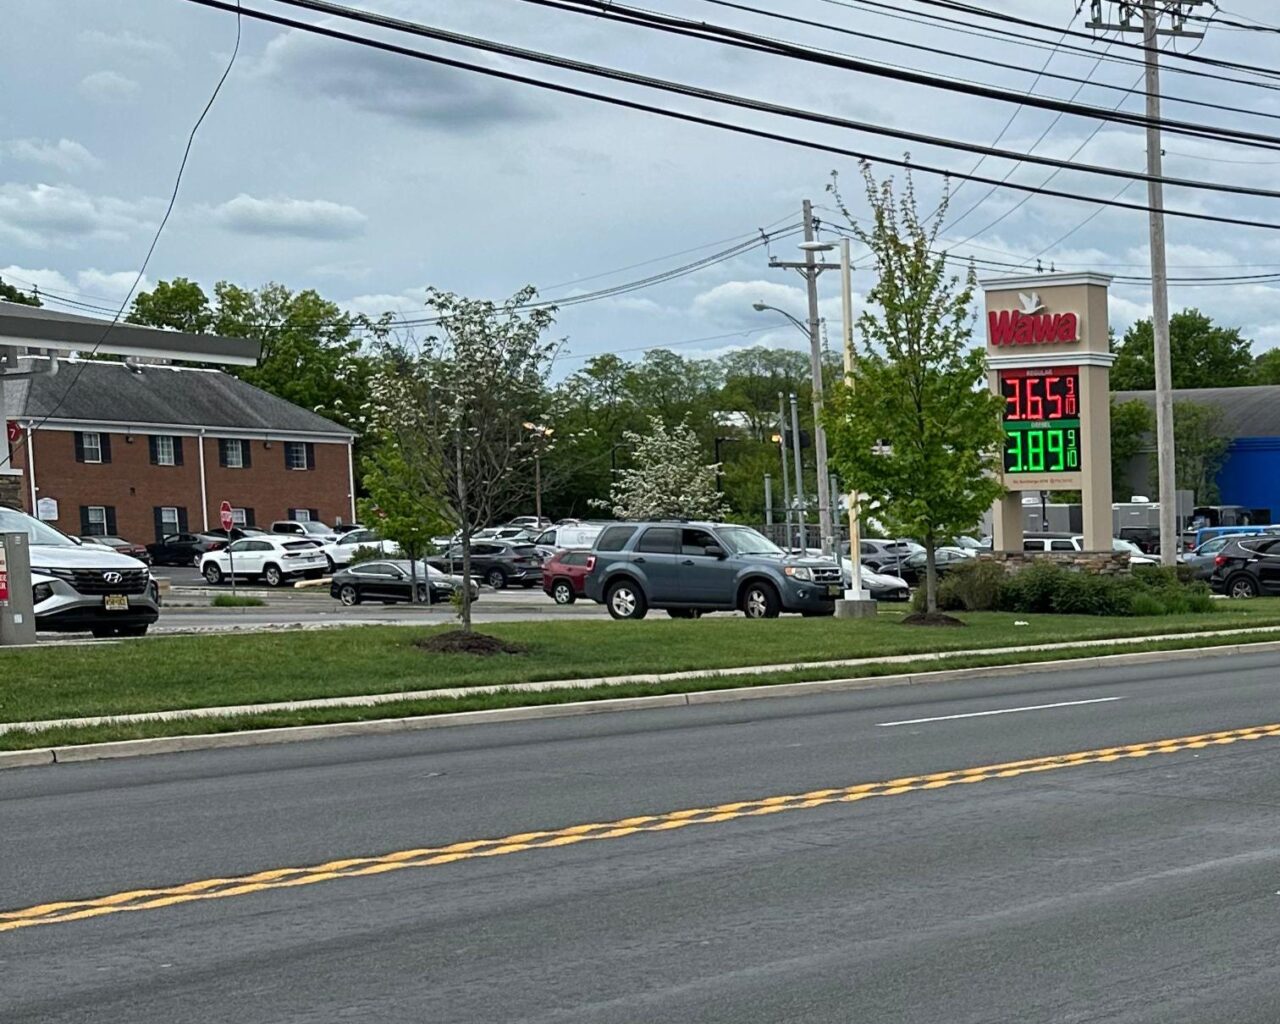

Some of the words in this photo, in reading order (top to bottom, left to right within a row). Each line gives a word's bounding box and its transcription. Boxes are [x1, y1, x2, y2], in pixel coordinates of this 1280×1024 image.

[988, 310, 1078, 345] Wawa
[1005, 378, 1062, 420] 3.65
[1007, 430, 1064, 471] 3.89
